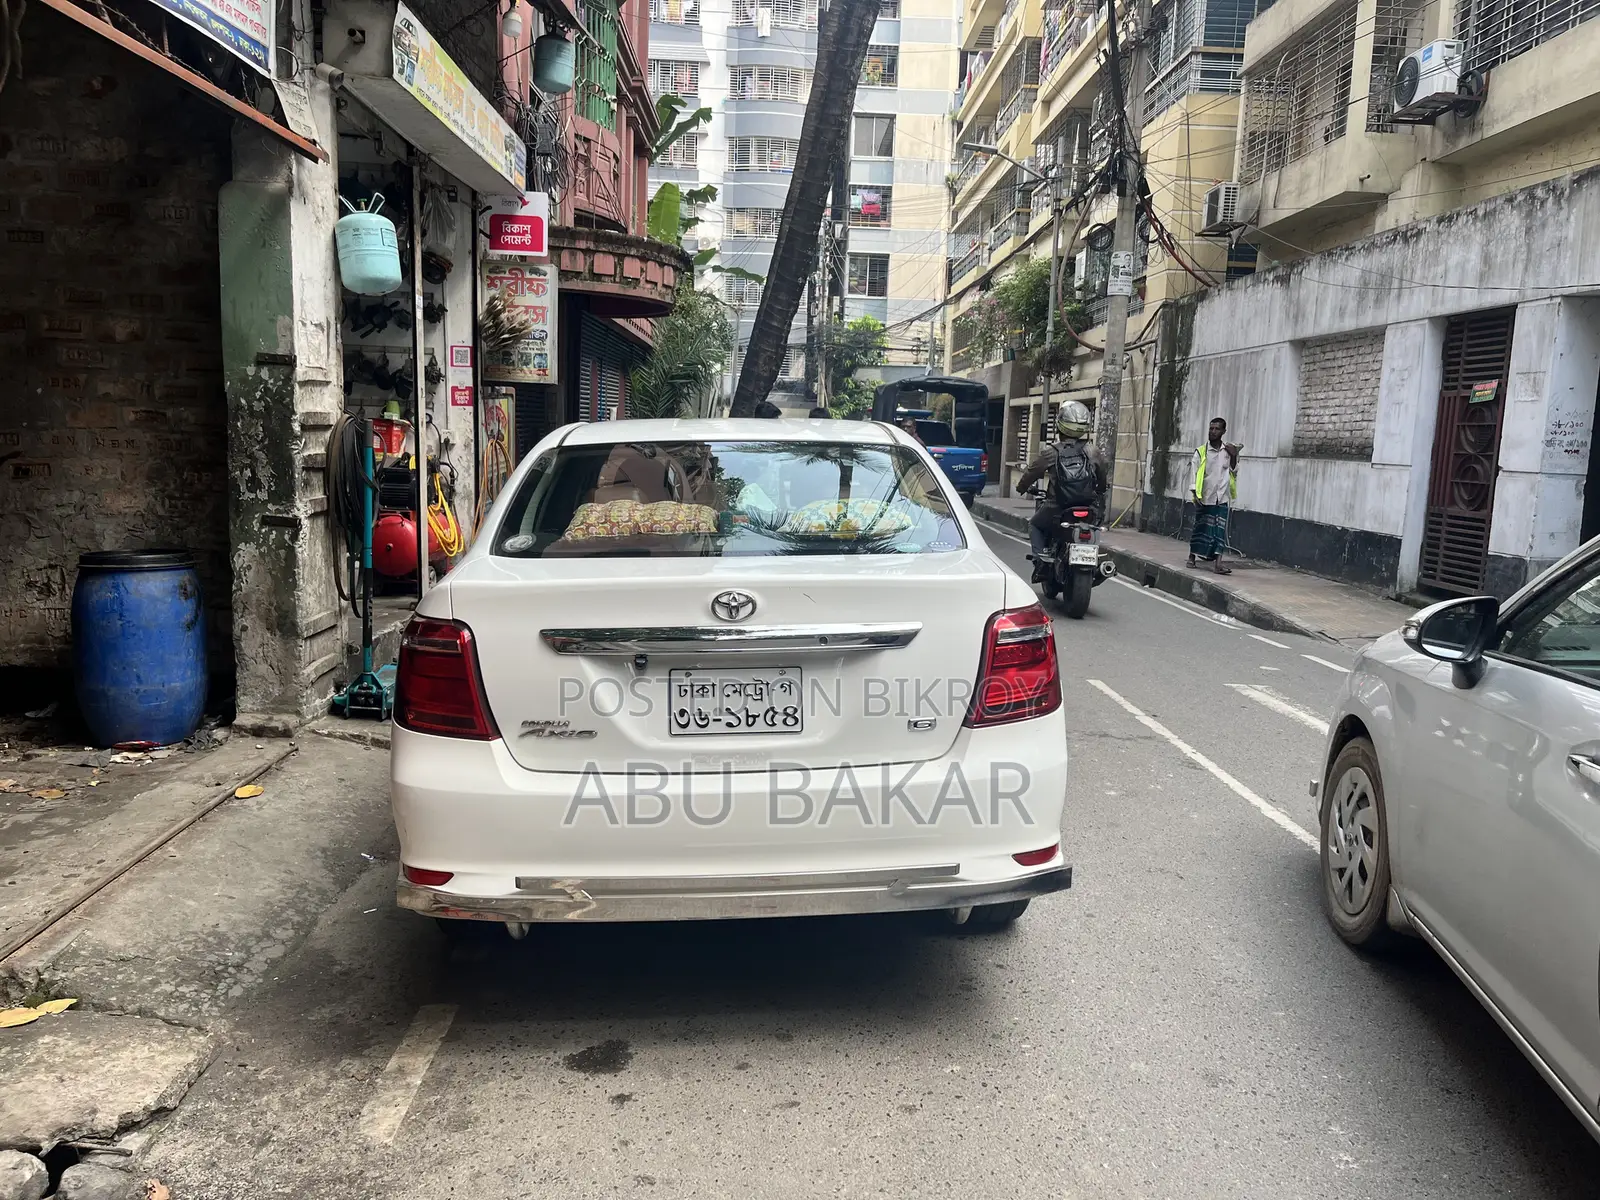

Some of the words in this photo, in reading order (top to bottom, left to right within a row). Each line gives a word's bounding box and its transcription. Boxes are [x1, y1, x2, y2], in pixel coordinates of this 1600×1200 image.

[502, 221, 531, 234] বিকাশ
[501, 234, 532, 246] পেমেন্ট
[486, 267, 548, 297] শরীফ
[951, 463, 975, 472] পুলিশ
[677, 680, 717, 699] ঢাকা
[673, 704, 800, 730] ৩৬-১৮৫৪
